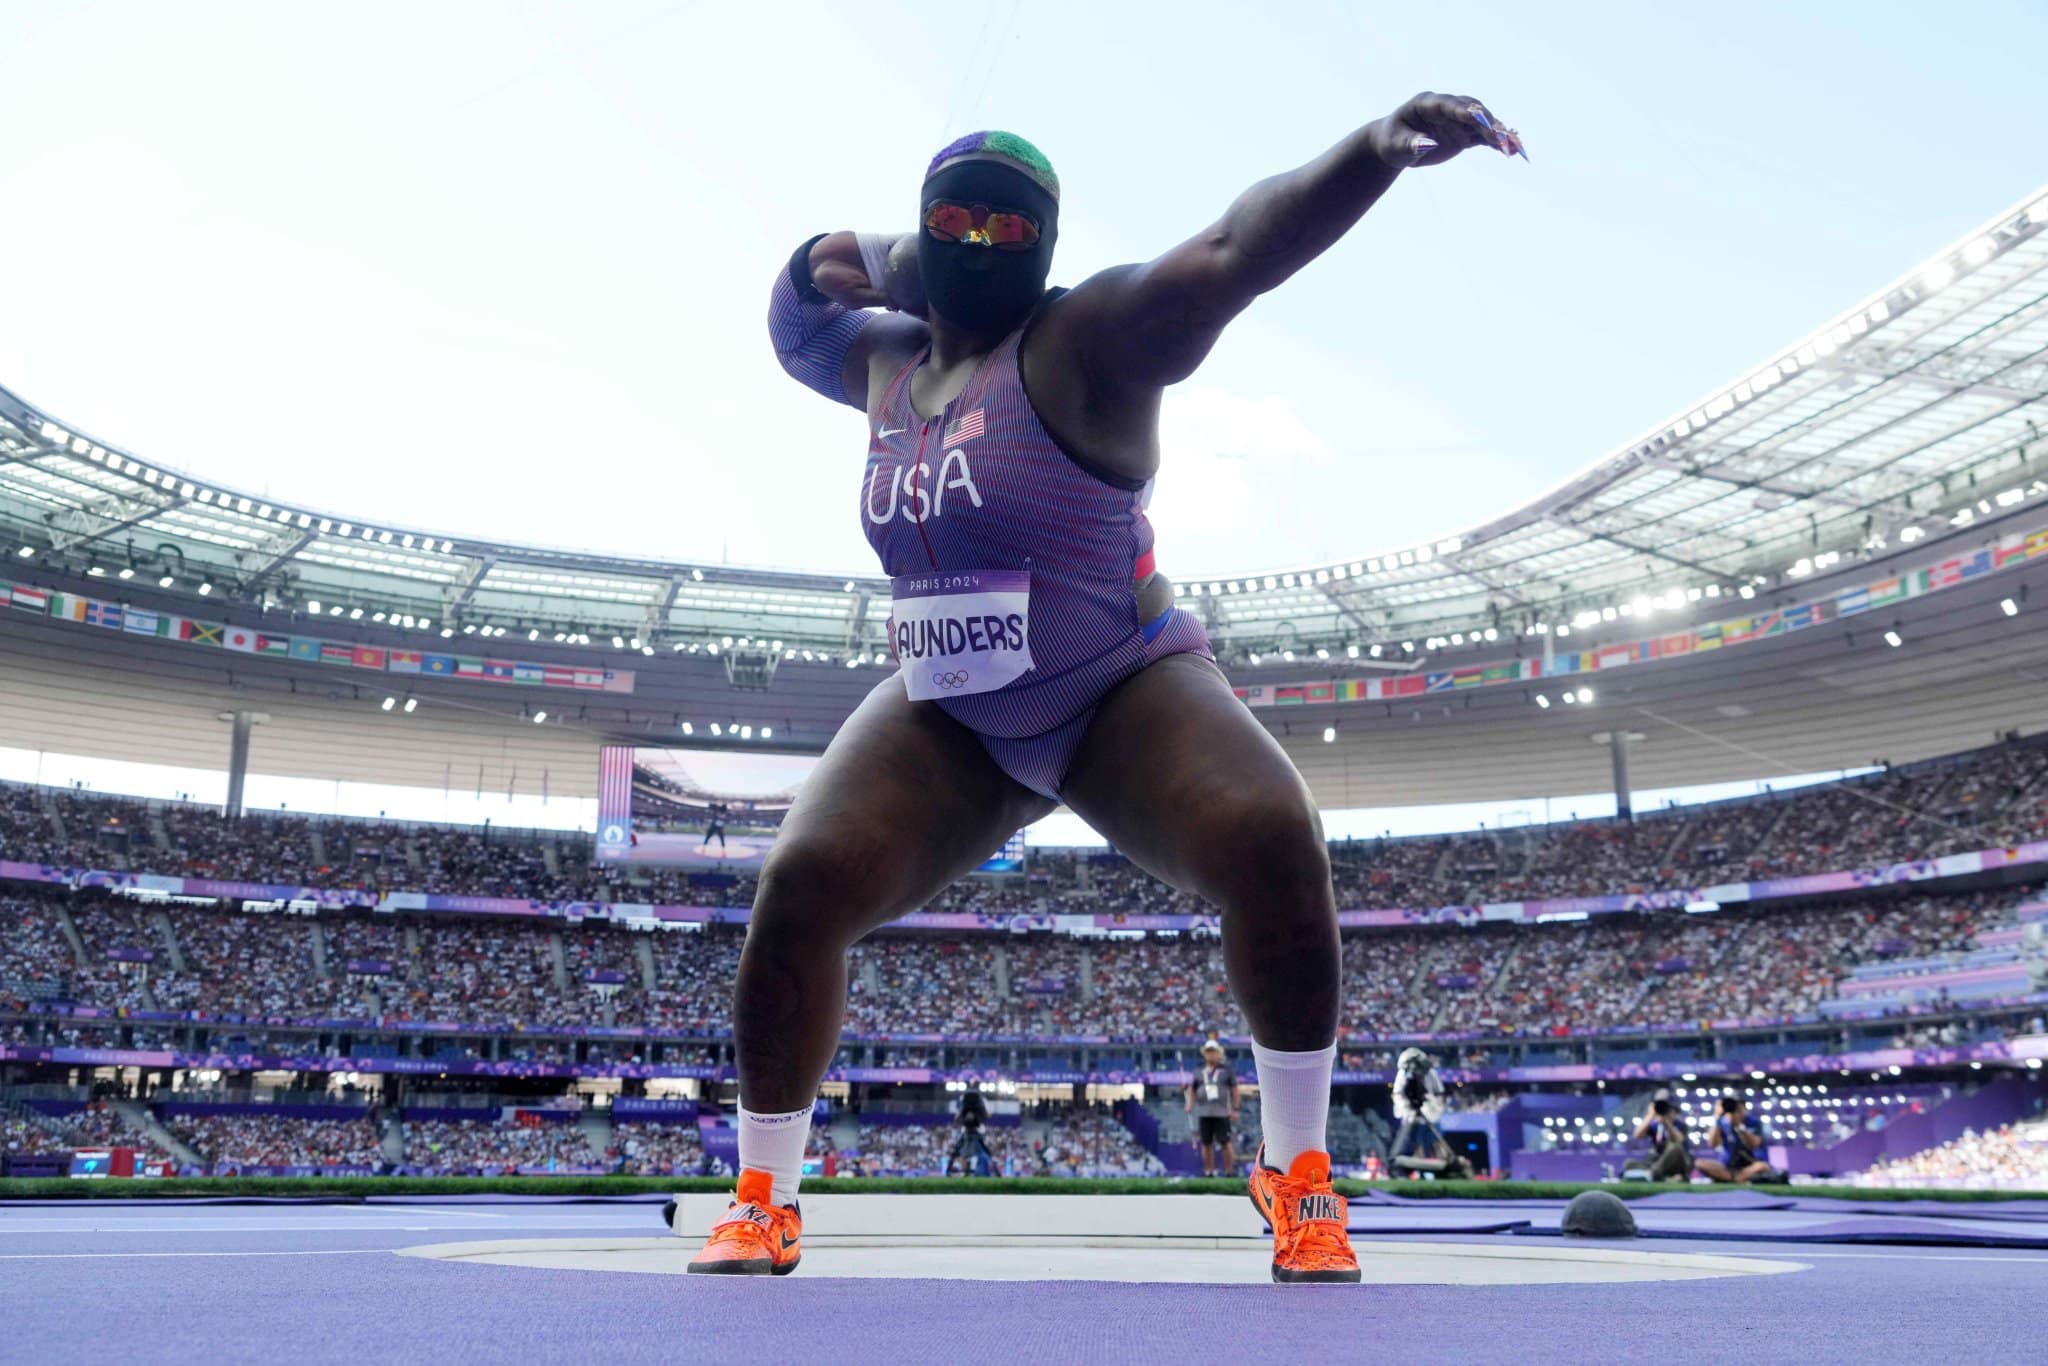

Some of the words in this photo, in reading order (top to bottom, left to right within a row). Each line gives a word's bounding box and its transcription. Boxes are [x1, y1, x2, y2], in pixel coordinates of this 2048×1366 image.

[868, 449, 983, 525] USA
[910, 578, 940, 592] PARIS
[944, 576, 980, 588] 2024
[623, 1100, 658, 1112] PARIS
[660, 1101, 692, 1112] 2024
[1298, 1195, 1341, 1223] NIKE
